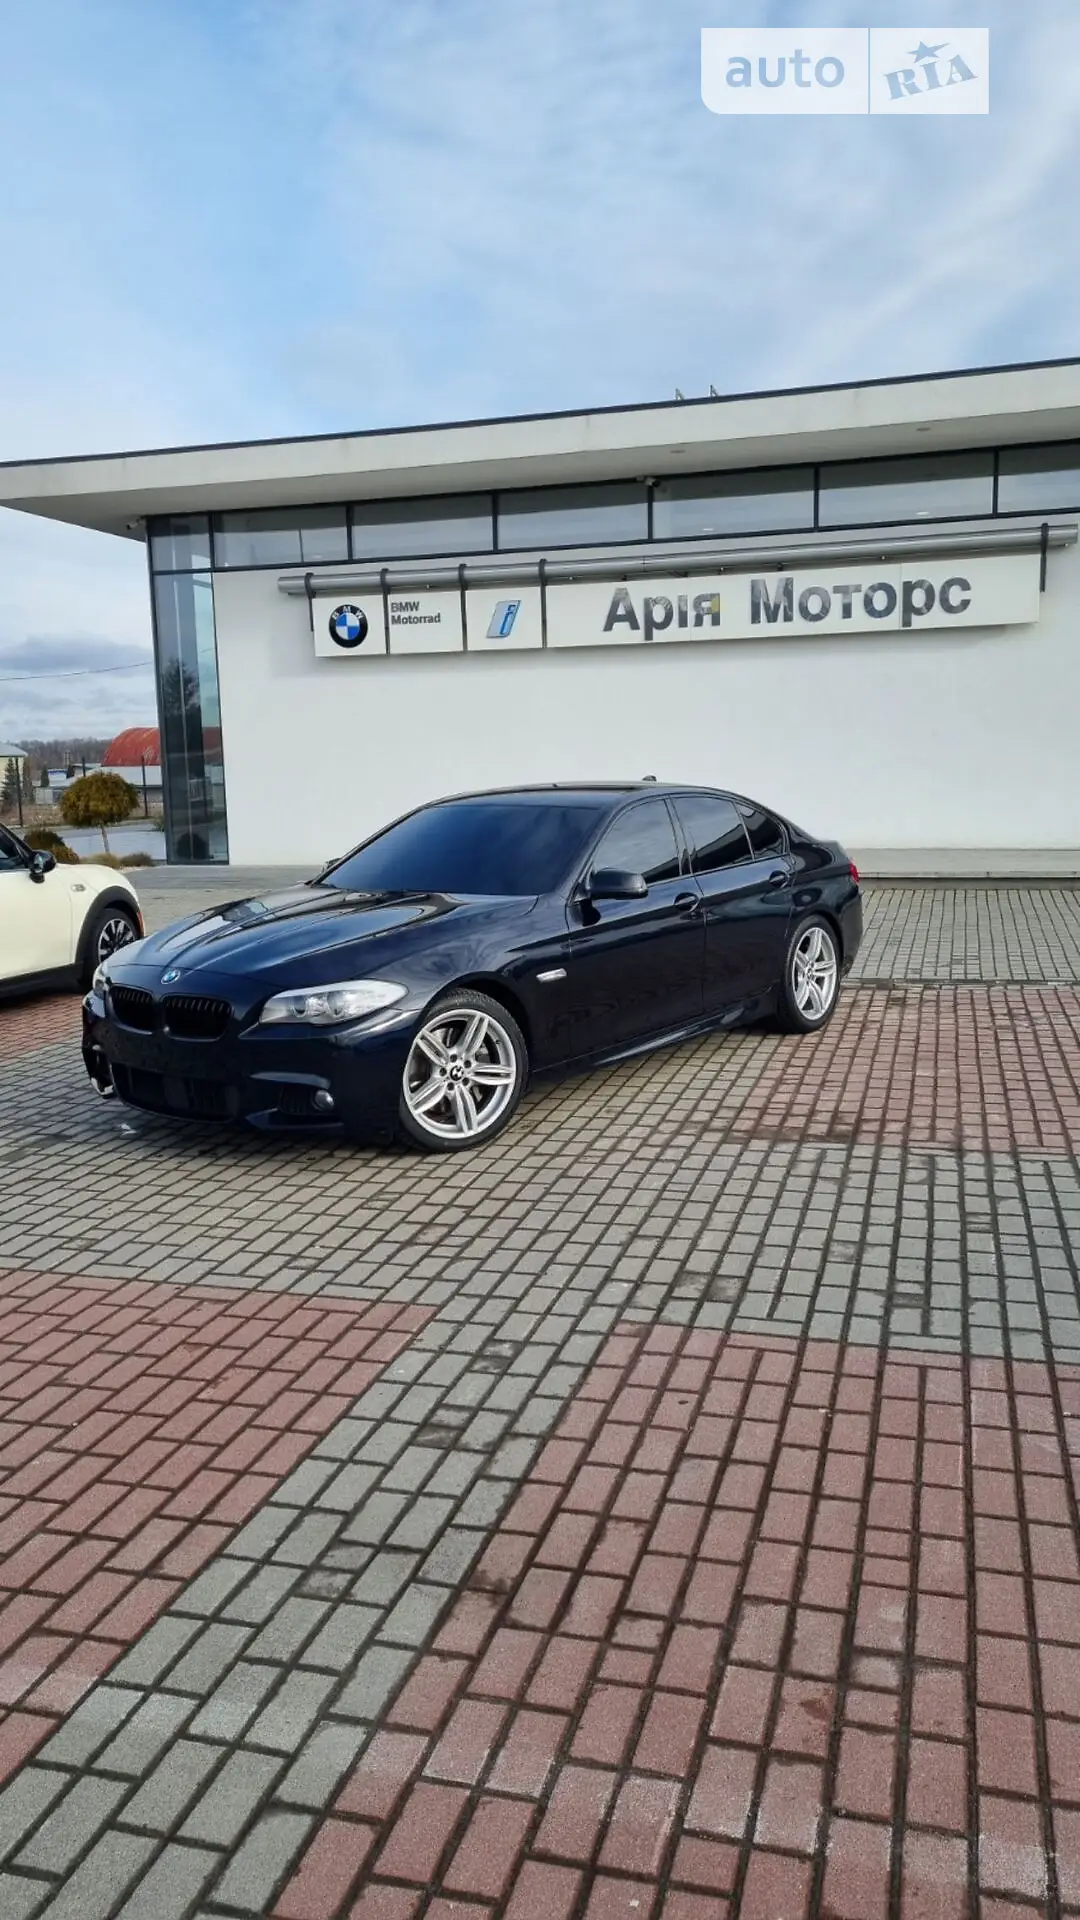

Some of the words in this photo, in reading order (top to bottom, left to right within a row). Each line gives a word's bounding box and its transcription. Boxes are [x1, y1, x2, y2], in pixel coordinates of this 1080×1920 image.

[390, 601, 420, 613] BMW
[602, 587, 721, 641] Арія
[750, 576, 971, 628] Моторс
[391, 612, 441, 625] Motorrad
